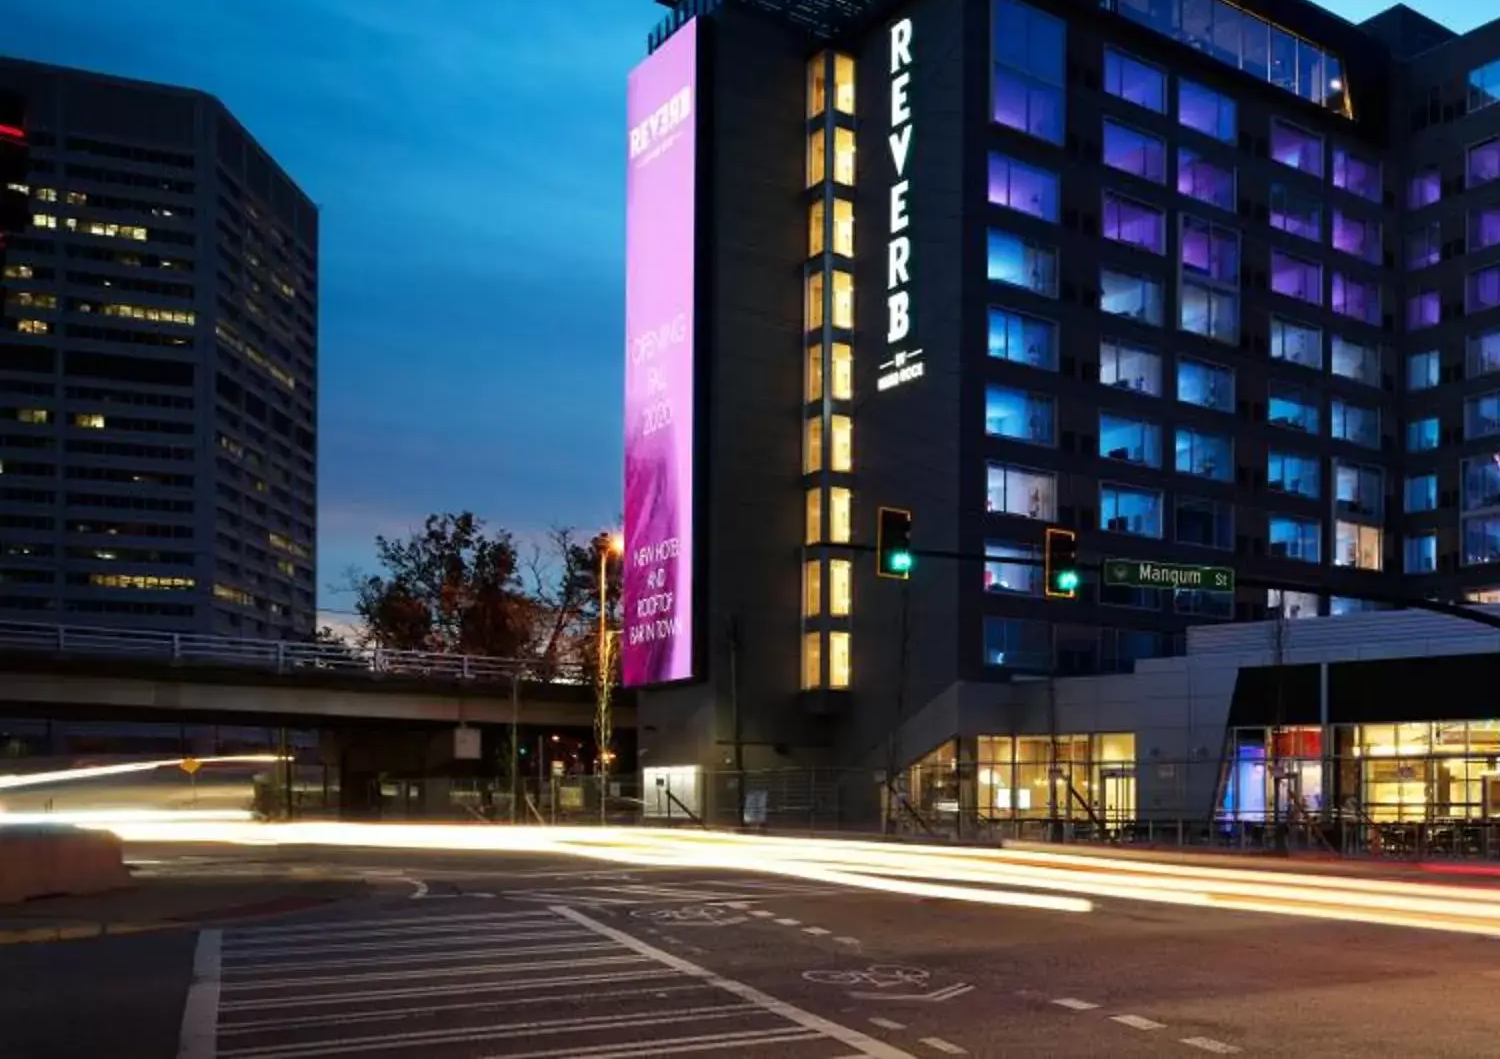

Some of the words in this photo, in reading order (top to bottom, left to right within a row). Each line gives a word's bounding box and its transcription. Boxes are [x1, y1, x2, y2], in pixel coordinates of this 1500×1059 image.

[886, 17, 912, 344] REVERB
[1139, 563, 1201, 587] Mangum
[1215, 572, 1229, 586] St
